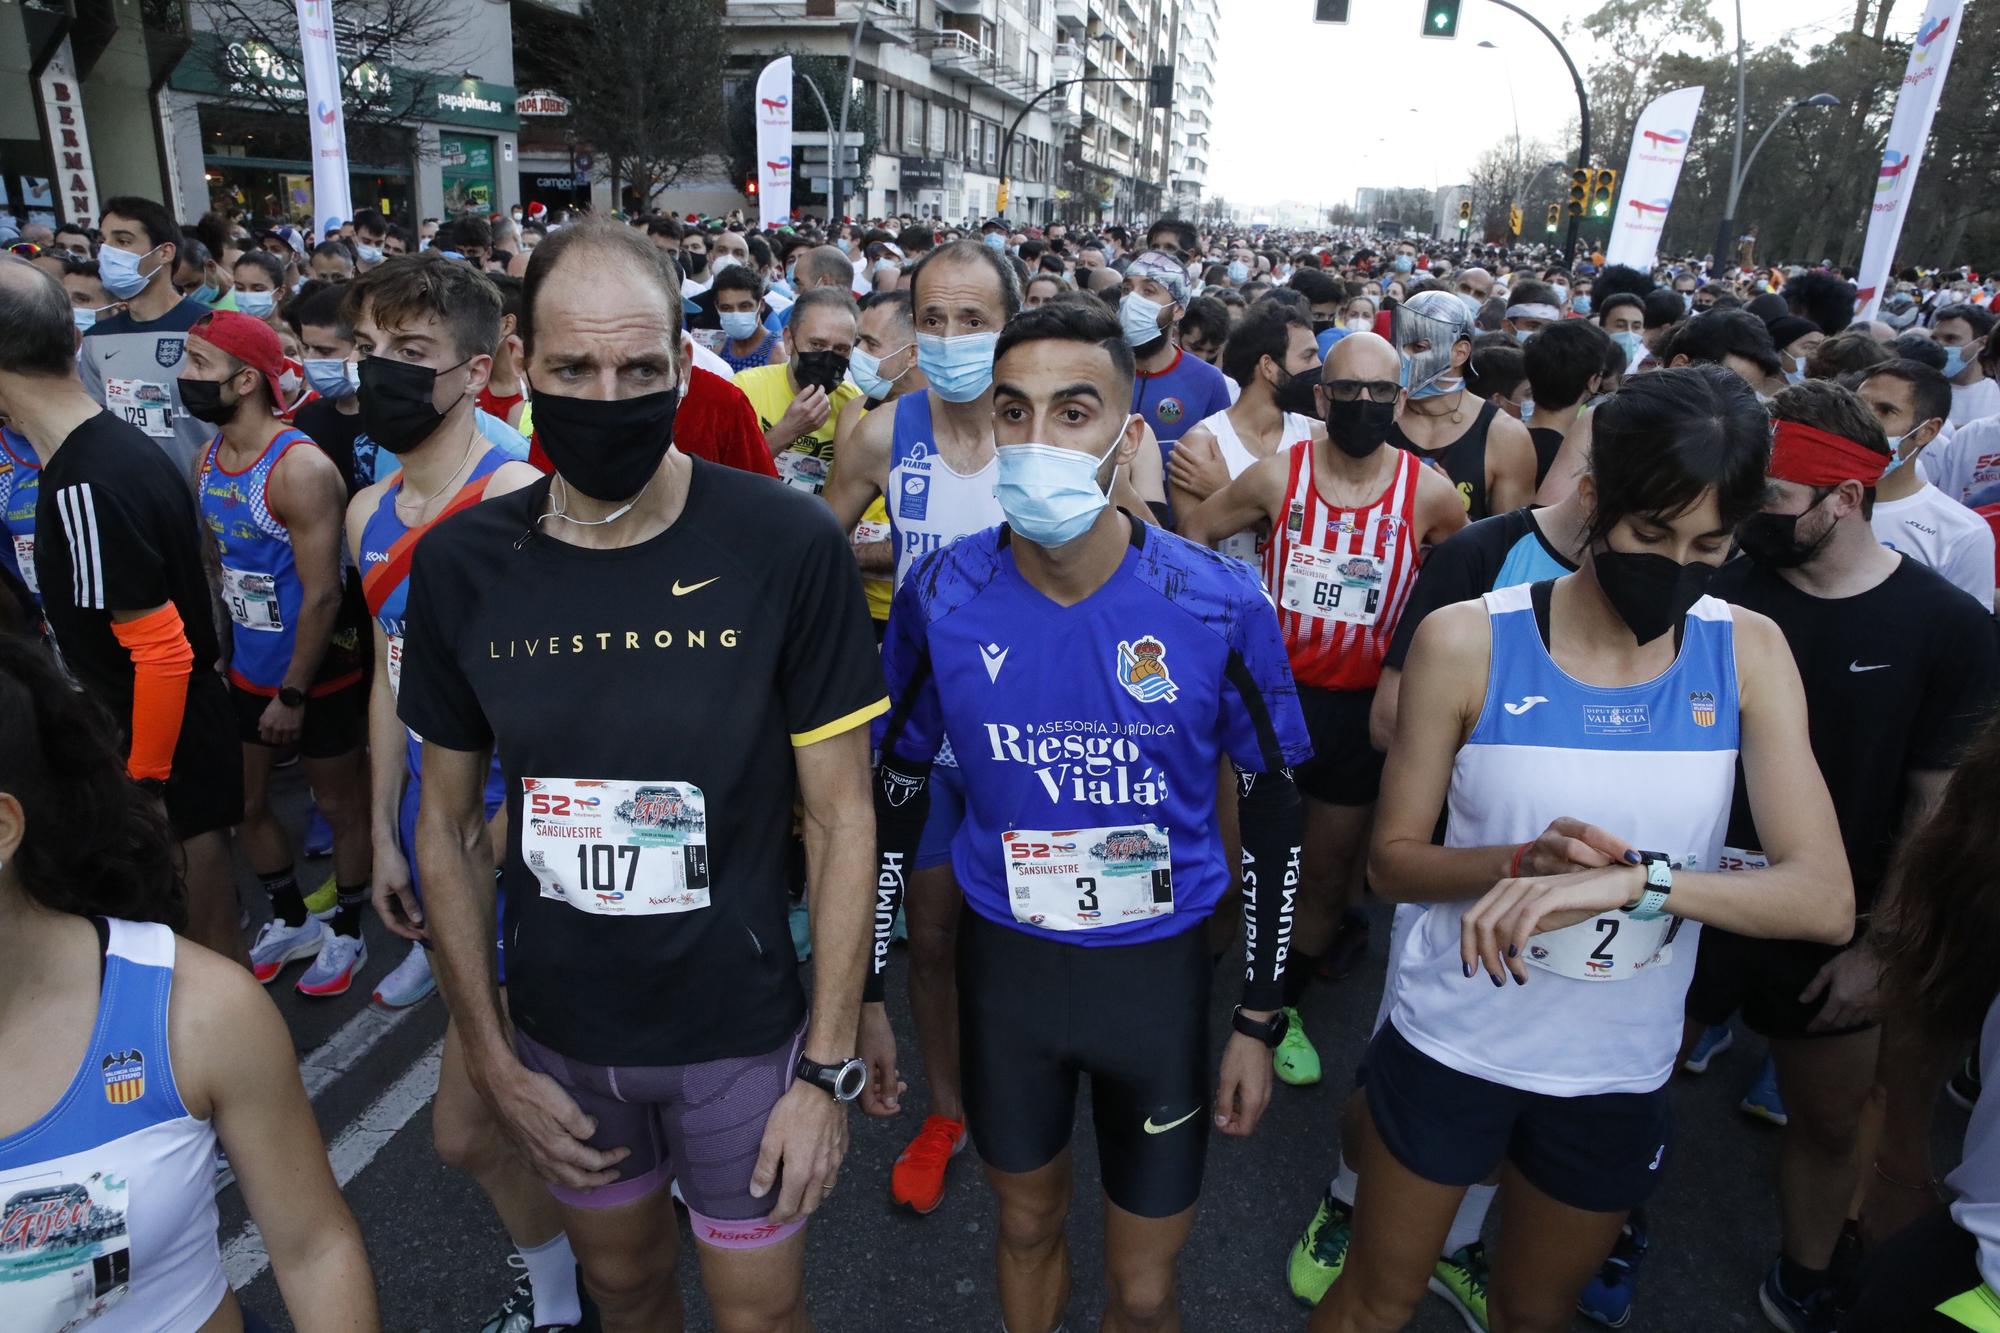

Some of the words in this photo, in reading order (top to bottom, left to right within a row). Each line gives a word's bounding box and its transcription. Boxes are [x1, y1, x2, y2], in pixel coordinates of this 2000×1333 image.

[438, 92, 502, 113] papajohns.es
[517, 98, 538, 112] PAPA
[109, 385, 122, 395] 52
[124, 406, 148, 427] 129
[903, 458, 932, 471] VIATOR
[858, 526, 870, 537] 52
[1291, 552, 1315, 566] 52
[1313, 581, 1342, 607] 69
[233, 596, 248, 619] 51
[490, 629, 738, 659] LIVESTRONG
[1036, 720, 1108, 736] ASESORÍA
[1111, 721, 1176, 737] JURÍDICA
[984, 723, 1140, 776] Riesgo
[887, 771, 918, 786] TRIUMPH
[531, 793, 570, 816] 52
[536, 824, 602, 839] SANSILVESTRE
[1011, 843, 1051, 859] 52
[577, 843, 641, 891] 107
[1018, 863, 1080, 876] SANSILVESTRE
[1076, 877, 1099, 910] 3
[874, 851, 905, 975] TRIUMPH
[1273, 845, 1302, 982] TRIUMPH
[1590, 918, 1620, 960] 2
[107, 1071, 142, 1083] ATLETISMO
[1, 1196, 94, 1251] Gijón
